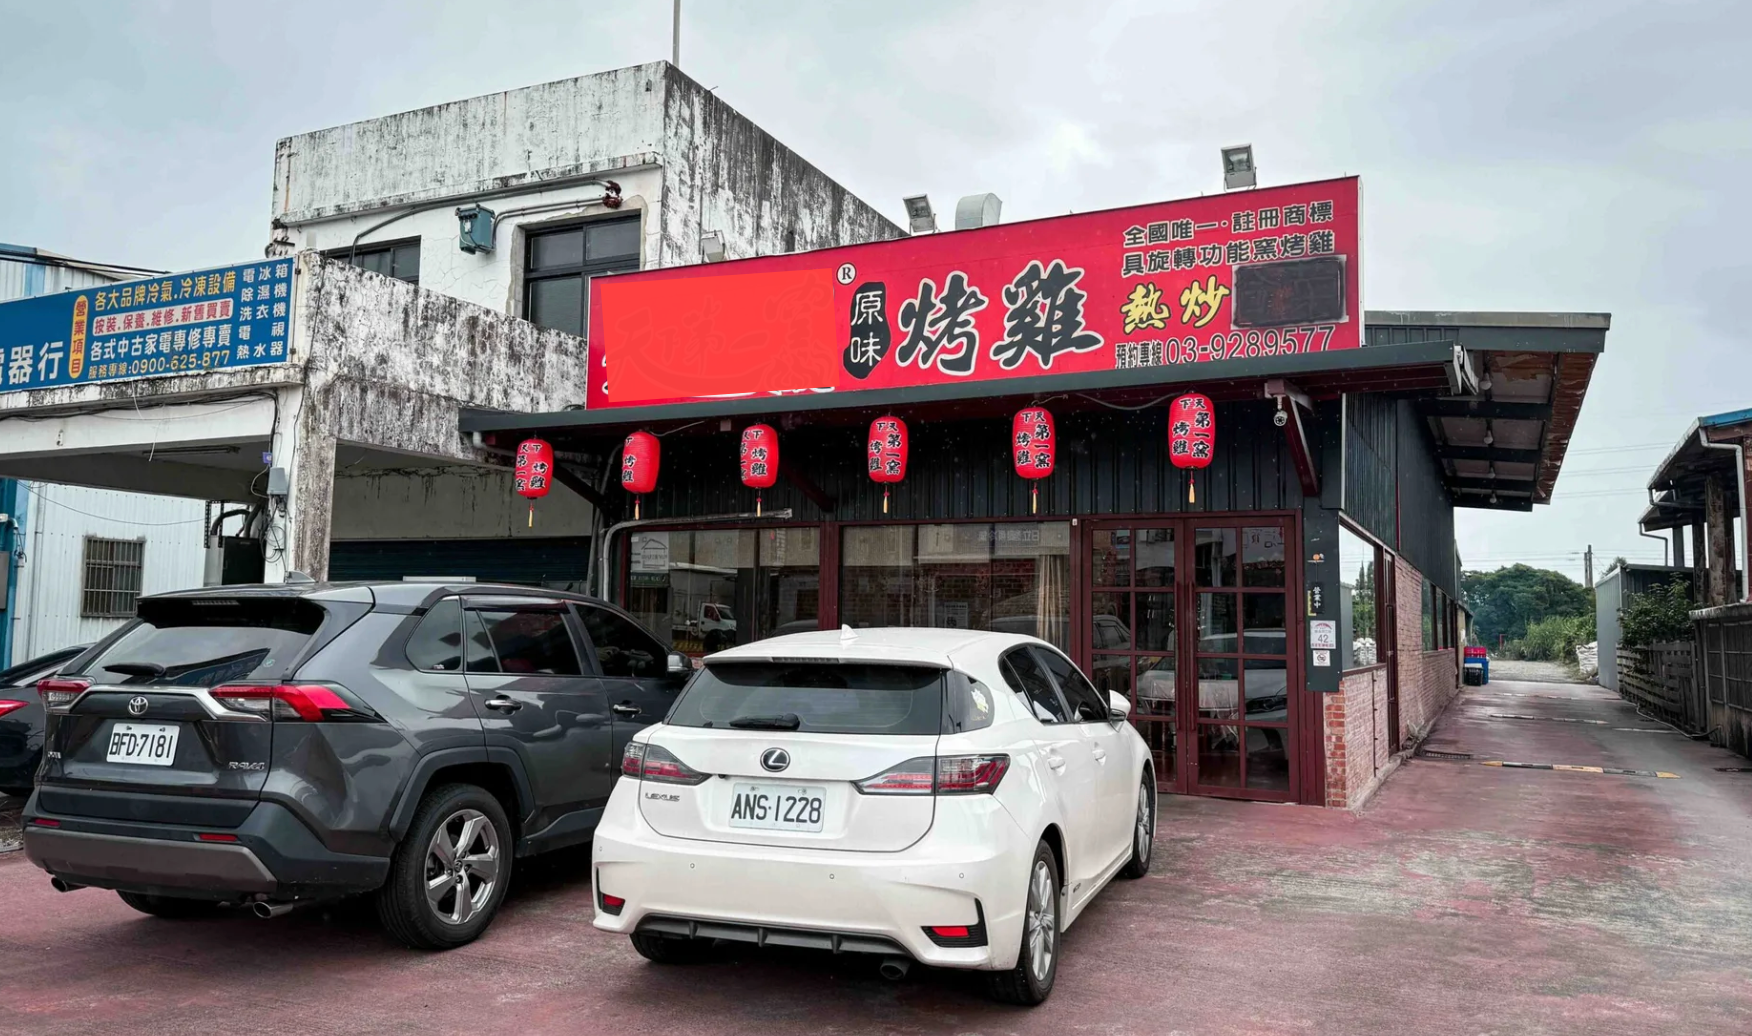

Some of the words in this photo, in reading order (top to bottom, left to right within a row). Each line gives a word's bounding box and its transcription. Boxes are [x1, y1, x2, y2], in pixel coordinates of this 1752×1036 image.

[243, 263, 288, 283] 電冰箱
[1121, 229, 1335, 278] 具旋轉功能窯烤雞
[239, 302, 286, 321] 洗衣機
[895, 258, 1105, 376] 烤雞
[1119, 274, 1231, 335] 熱炒
[71, 300, 87, 374] 營業項目
[90, 324, 232, 362] 各式中古家電專修專賣
[236, 341, 283, 360] 熱水器
[849, 290, 884, 367] 原味
[0, 341, 64, 386] 器行
[1317, 634, 1329, 645] 42
